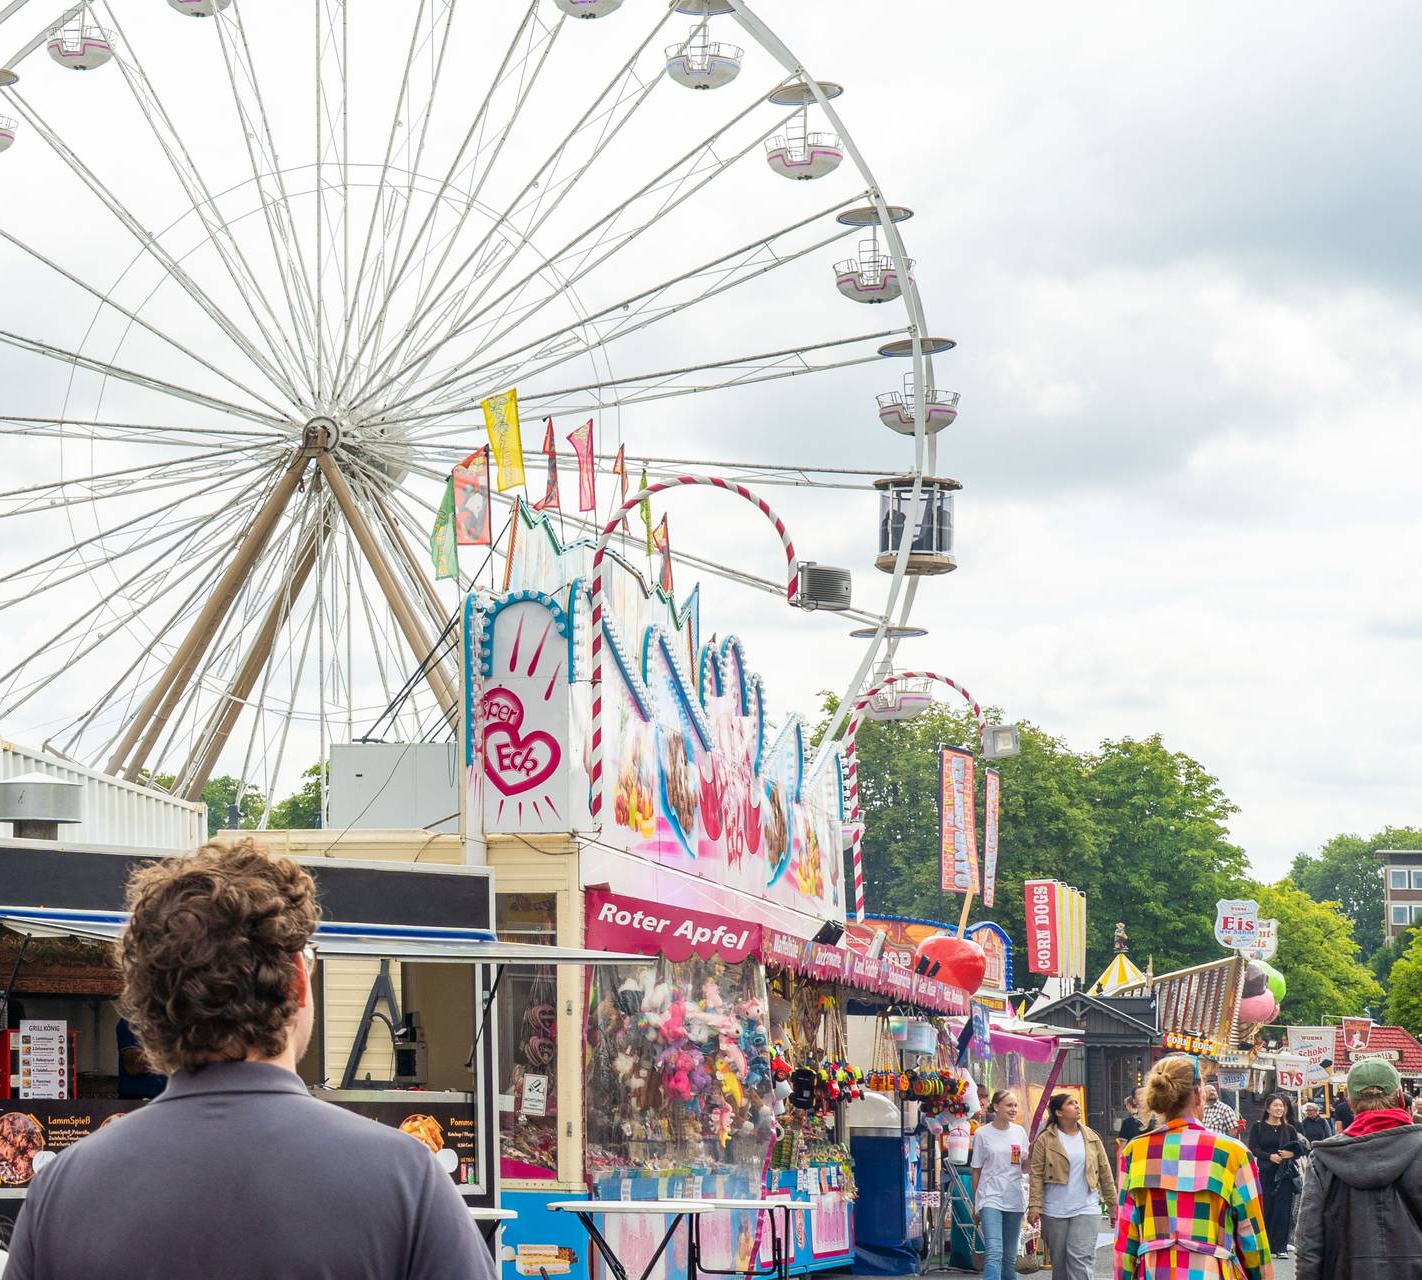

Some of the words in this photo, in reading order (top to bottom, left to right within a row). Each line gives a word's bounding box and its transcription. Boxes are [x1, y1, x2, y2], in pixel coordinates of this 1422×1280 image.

[1033, 886, 1049, 925] DOGS
[597, 902, 671, 933] Roter
[673, 920, 749, 950] Apfel
[1221, 916, 1255, 931] Eis
[1036, 930, 1051, 969] CORN
[1166, 1035, 1189, 1046] CORN
[48, 1116, 91, 1127] LammSpieß
[450, 1118, 474, 1126] Pomme
